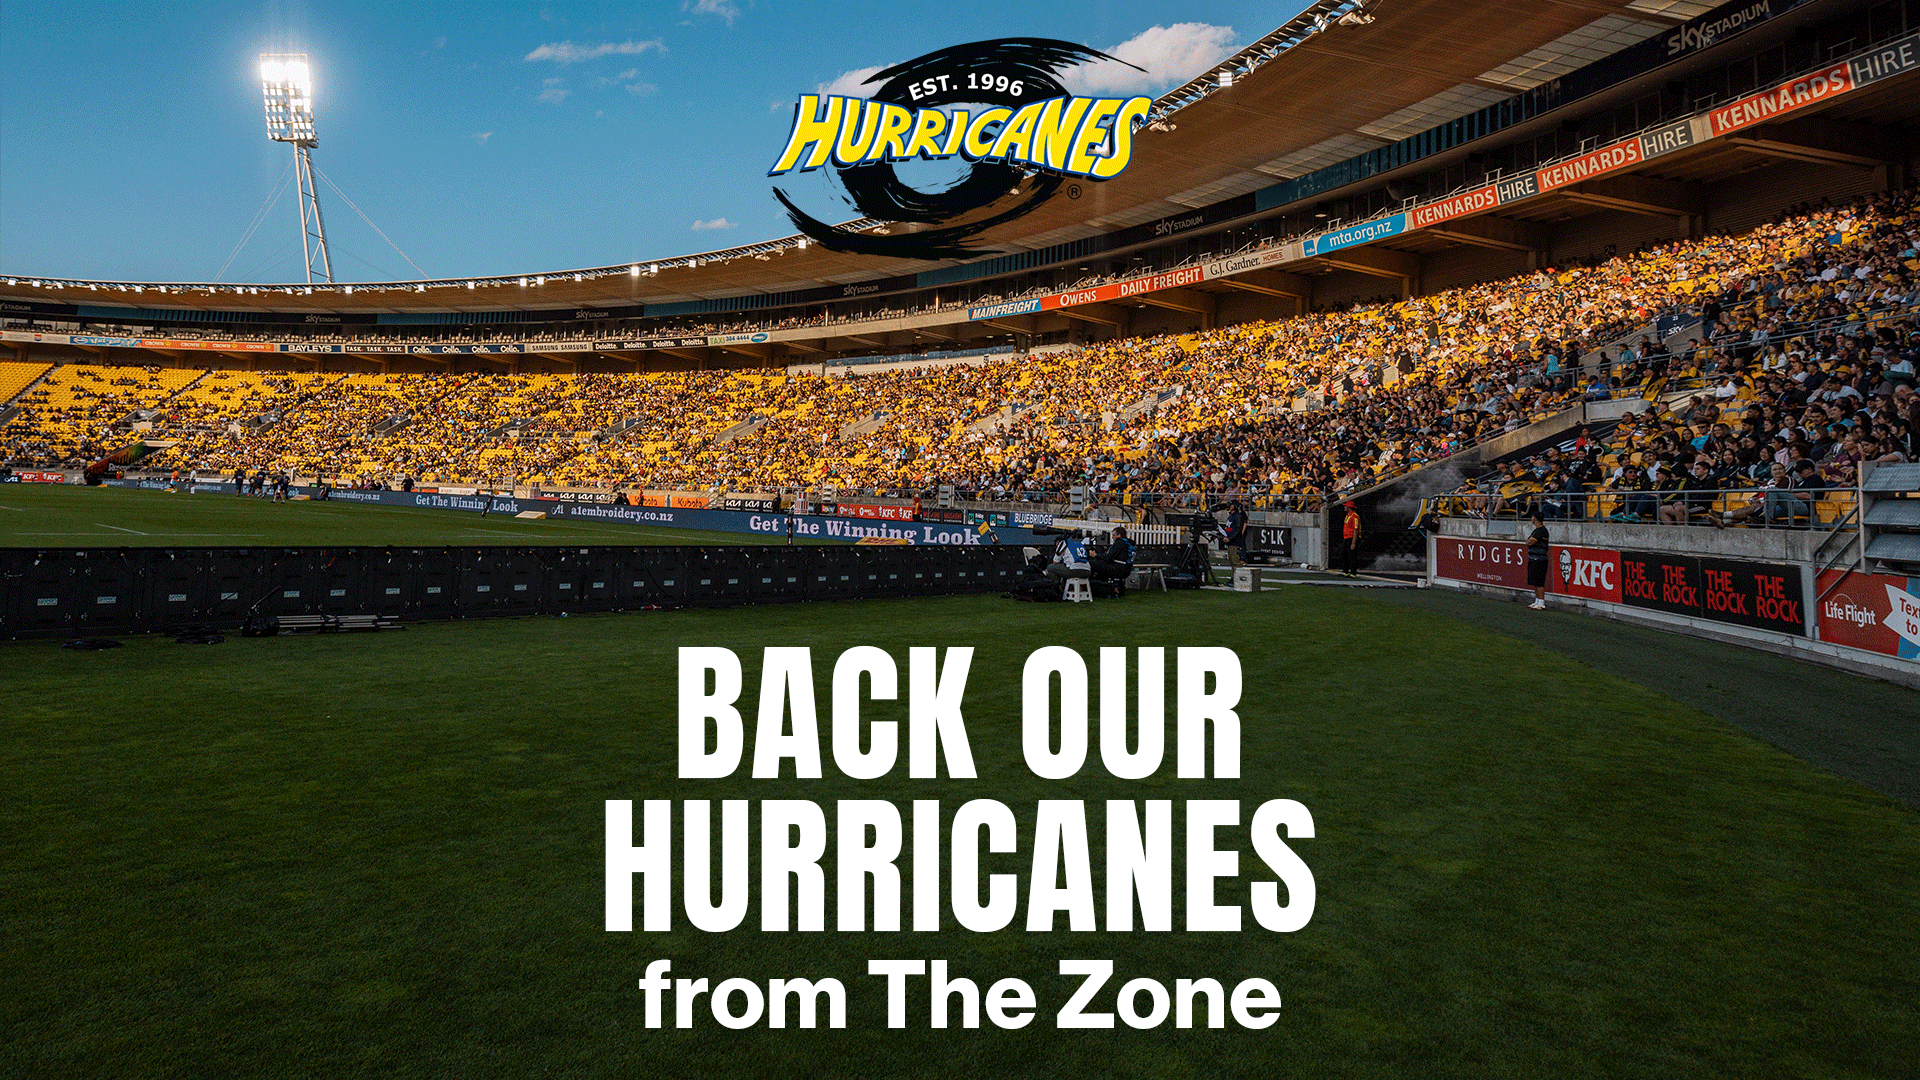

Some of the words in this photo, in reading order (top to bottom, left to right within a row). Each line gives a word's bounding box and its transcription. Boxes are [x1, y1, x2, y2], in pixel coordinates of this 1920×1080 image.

[1705, 0, 1770, 38] STADIUM
[1716, 68, 1845, 131] KENNARDS
[1854, 43, 1916, 83] HIRE
[1542, 143, 1637, 188] KENNARDS
[1643, 126, 1688, 156] HIRE
[1416, 189, 1495, 225] KENNARDS
[1499, 177, 1535, 201] HIRE
[1174, 216, 1203, 230] STADIUM
[1329, 222, 1392, 247] mta.org.nz
[1210, 264, 1225, 276] G.J.
[1262, 251, 1283, 262] HOMES
[857, 285, 879, 293] STADIUM
[1060, 290, 1097, 306] OWENS
[1120, 278, 1151, 296] DAILY
[1153, 268, 1201, 289] FREIGHT
[972, 299, 1039, 320] MAINFREIGHT
[709, 336, 725, 345] TAXI
[416, 495, 430, 506] Get
[432, 496, 448, 507] The
[493, 500, 518, 512] Look
[571, 506, 674, 522] a1embroidery.co.nz
[882, 509, 895, 518] KFC
[1014, 513, 1053, 524] BLUEBRIDGE
[749, 515, 779, 532] Get
[825, 519, 917, 545] Winning
[923, 526, 981, 545] Look
[1458, 544, 1524, 566] RYDGES
[1477, 573, 1502, 581] WELLINGTON
[1573, 559, 1614, 590] KFC
[1624, 561, 1646, 580] THE
[1662, 564, 1687, 586] THE
[1705, 569, 1734, 592] THE
[1754, 574, 1785, 599] THE
[1825, 601, 1844, 620] Life
[1845, 604, 1876, 628] Flight
[1906, 619, 1918, 636] to
